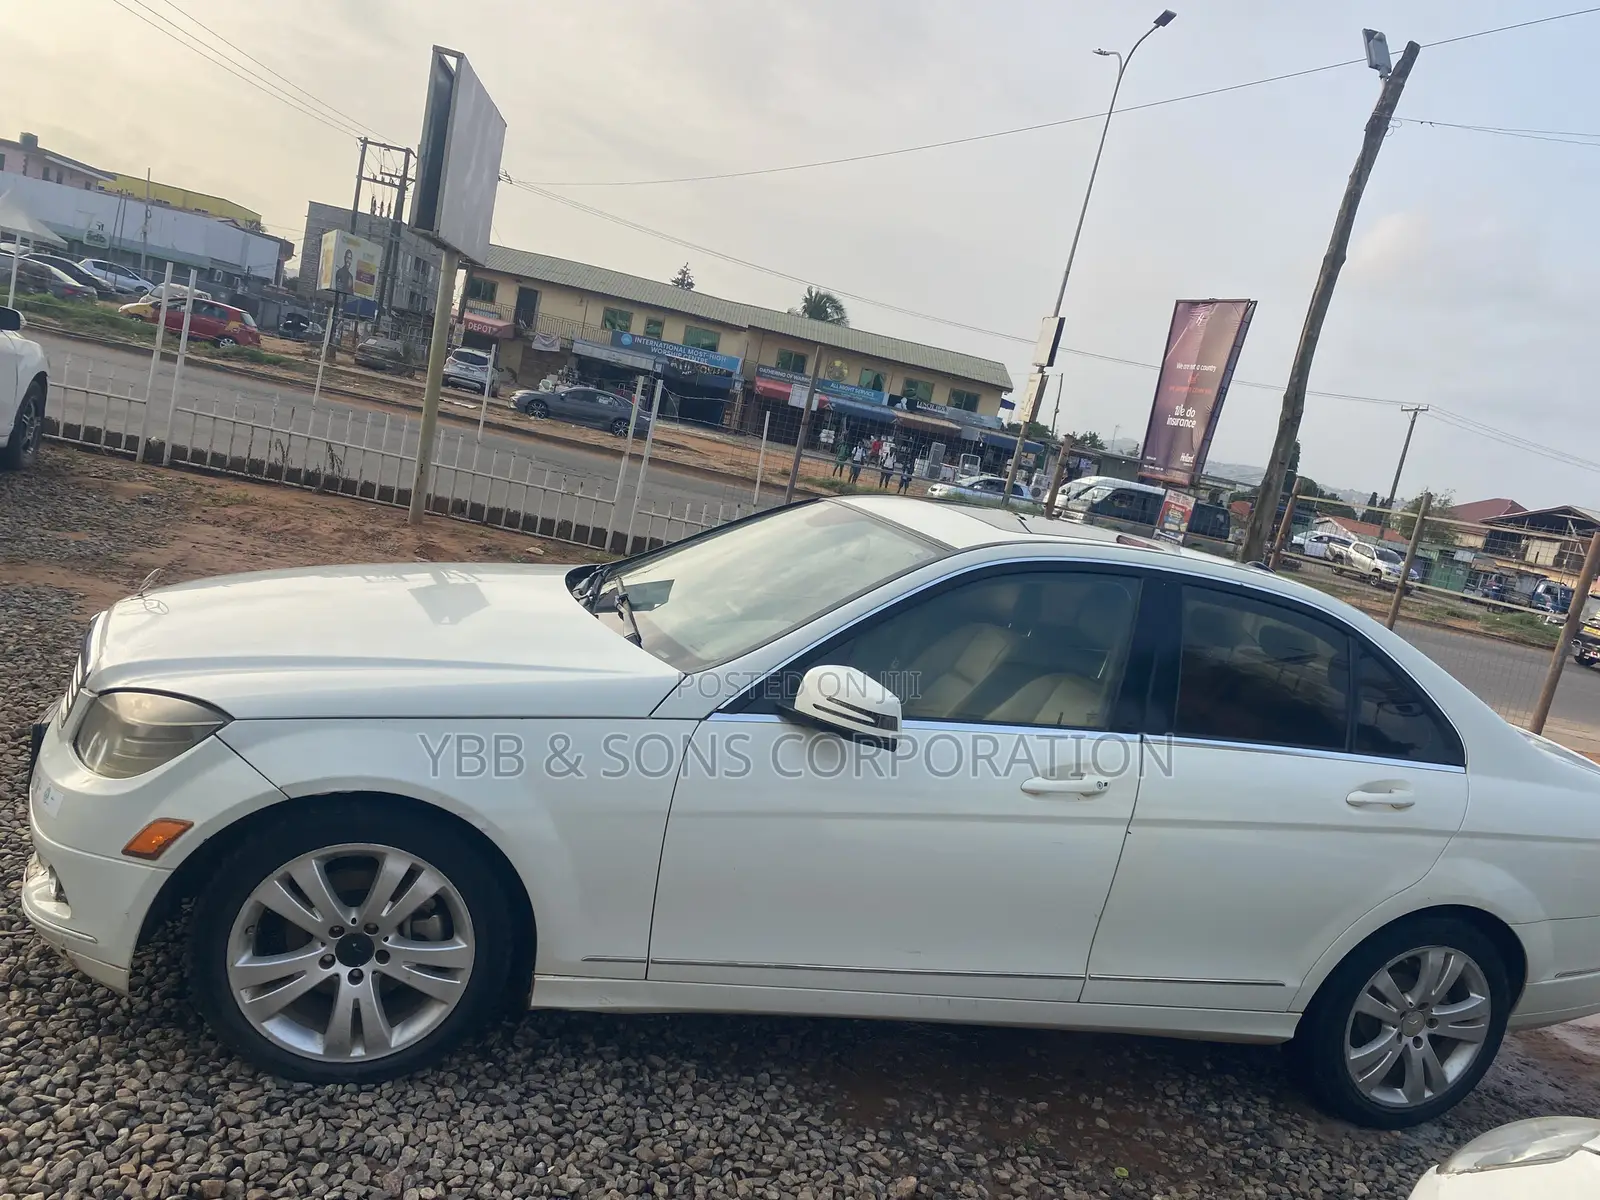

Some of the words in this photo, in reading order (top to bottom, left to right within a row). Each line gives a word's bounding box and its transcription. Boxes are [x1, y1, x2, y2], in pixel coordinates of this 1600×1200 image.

[468, 322, 492, 335] DEPOT
[634, 336, 686, 354] INTERNATIONAL
[687, 348, 727, 363] MOST-HIGH
[650, 346, 682, 358] WORSHIP
[682, 352, 709, 365] CENTRE
[1186, 406, 1196, 418] do
[1166, 414, 1197, 428] insurance
